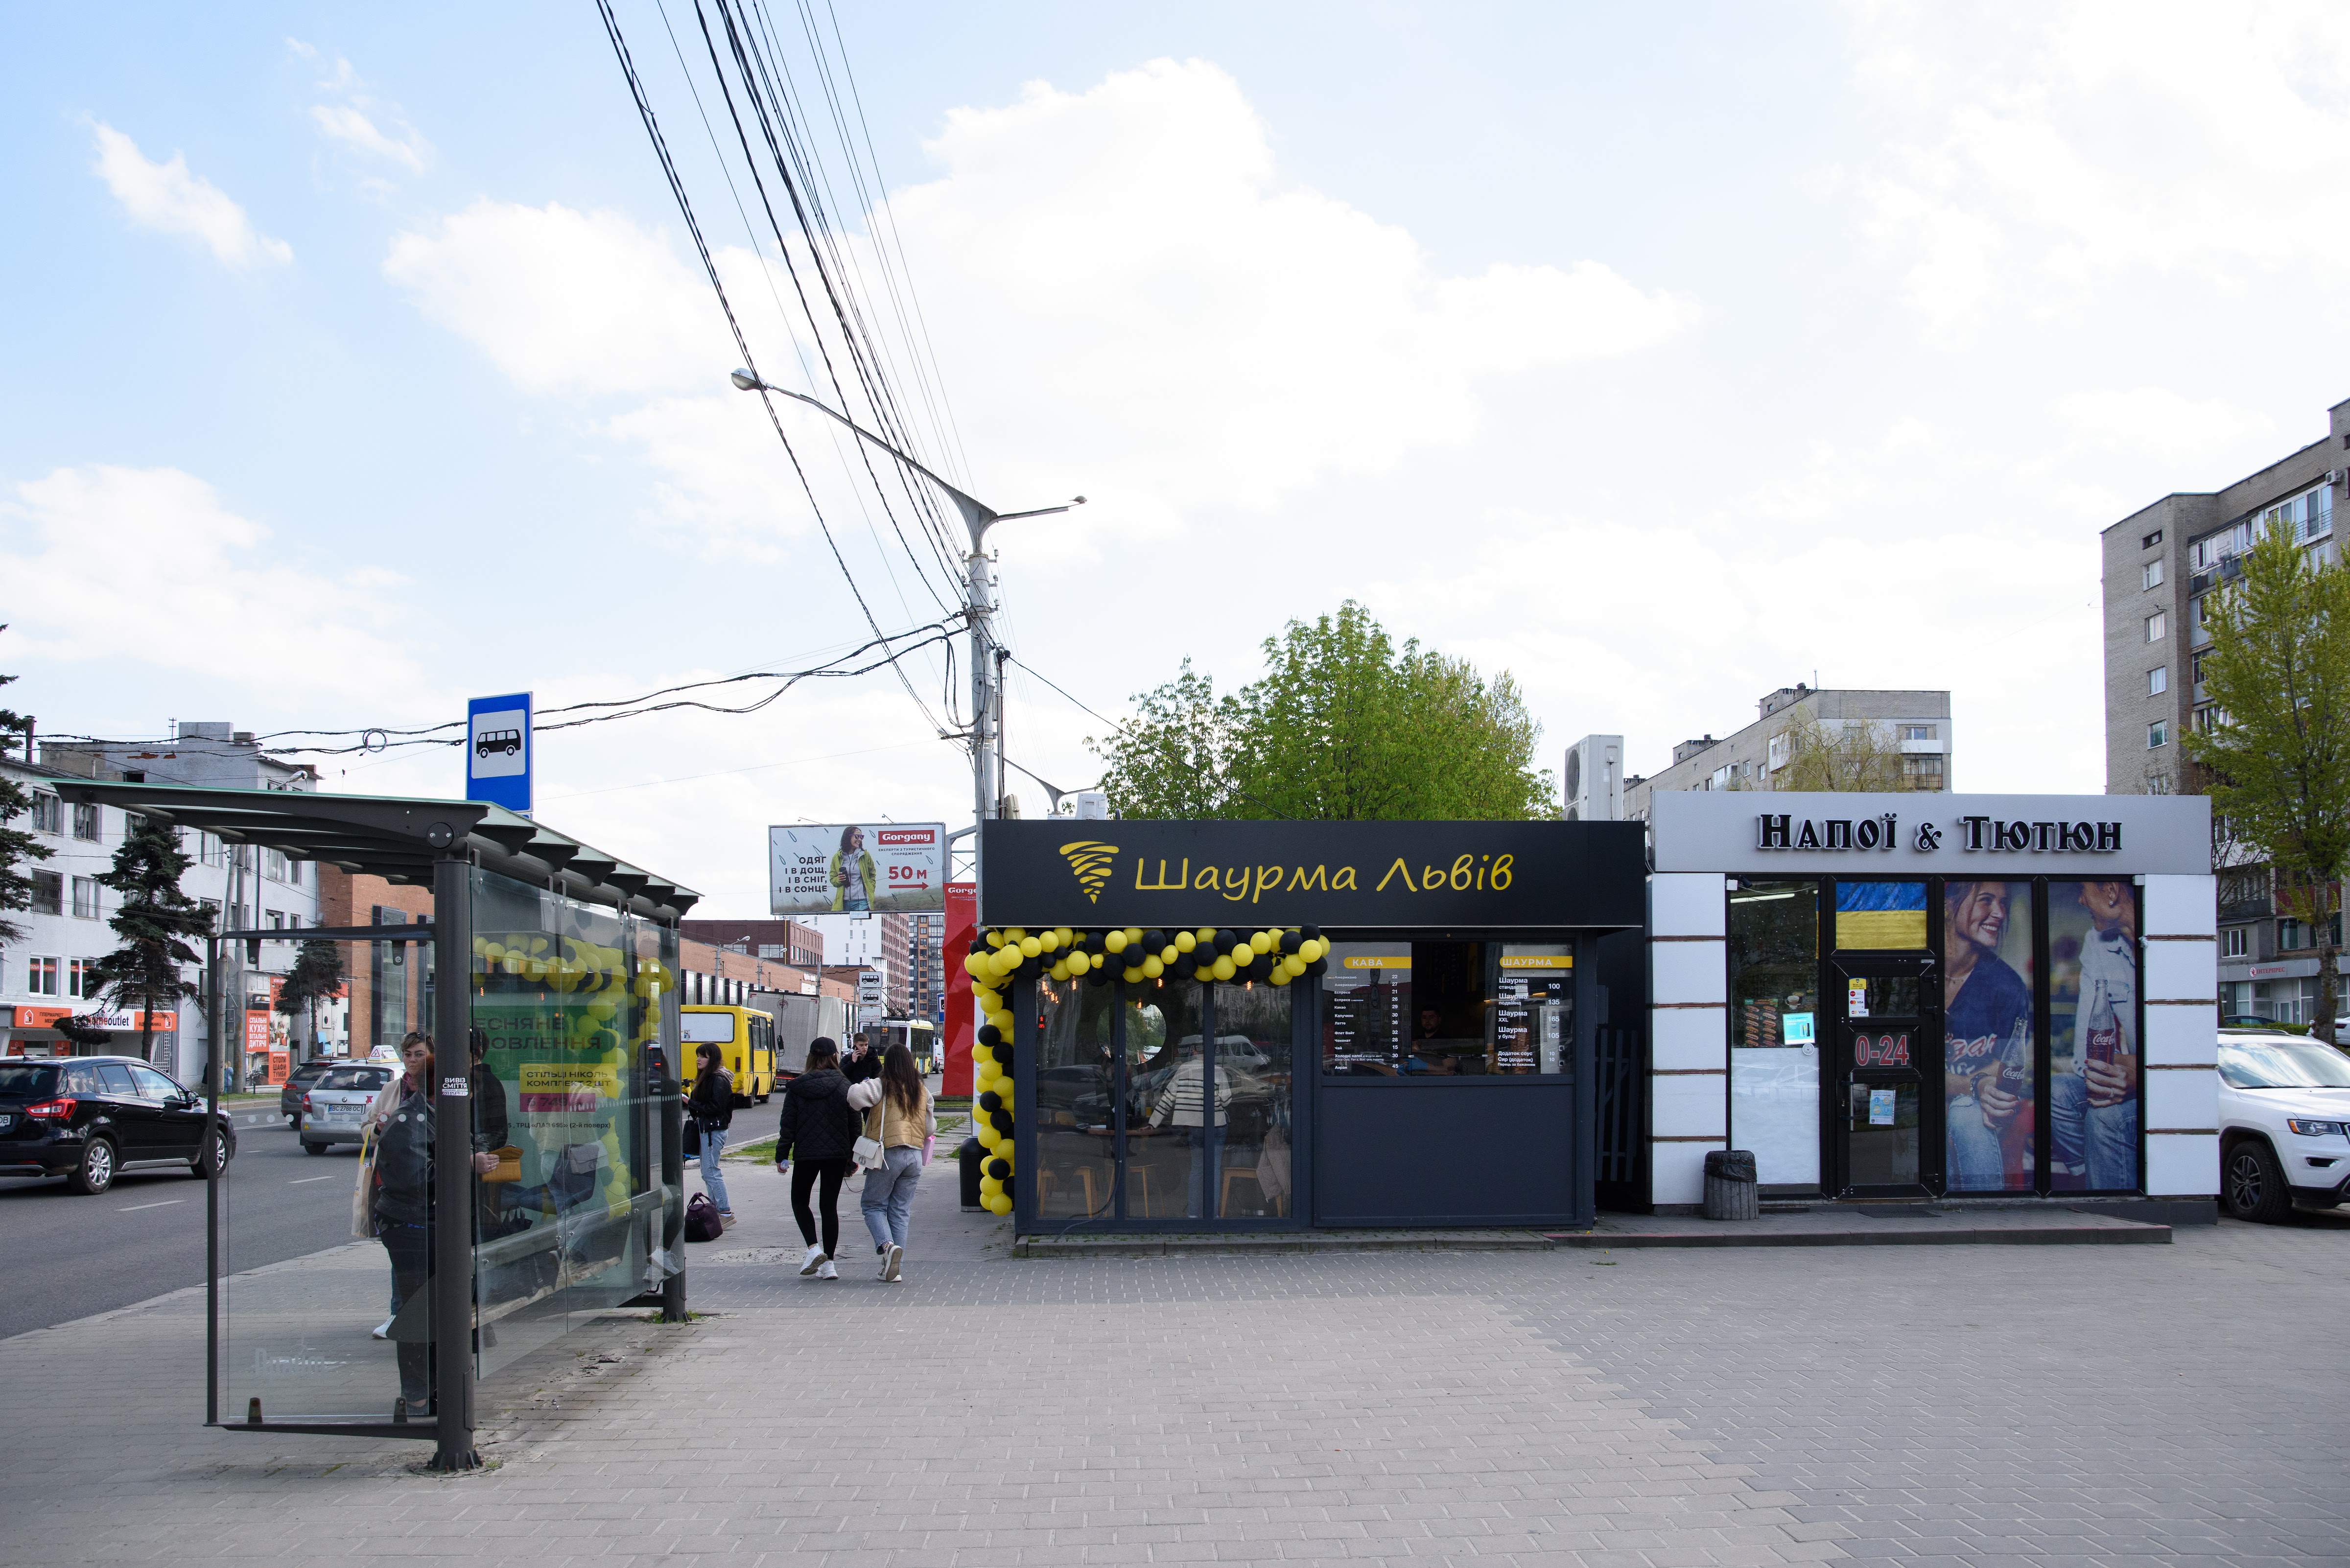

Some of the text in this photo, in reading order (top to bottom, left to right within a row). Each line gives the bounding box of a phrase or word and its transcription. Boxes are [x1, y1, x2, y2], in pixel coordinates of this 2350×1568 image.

[882, 833, 930, 843] Gorgany
[1915, 821, 1942, 851] &
[799, 856, 826, 865] ОДЯГ
[800, 867, 827, 875] ДОЩ,
[889, 866, 913, 880] 50
[803, 876, 827, 884] СНІГ,
[1135, 854, 1514, 904] Шаурма Львів
[249, 1024, 267, 1032] КУХНІ
[473, 1017, 564, 1030] ЕСНЯНЕ
[249, 1040, 267, 1049] ДИТЯЧІ
[491, 1037, 601, 1050] ОВЛЕННЯ
[1856, 1035, 1909, 1066] 0-24
